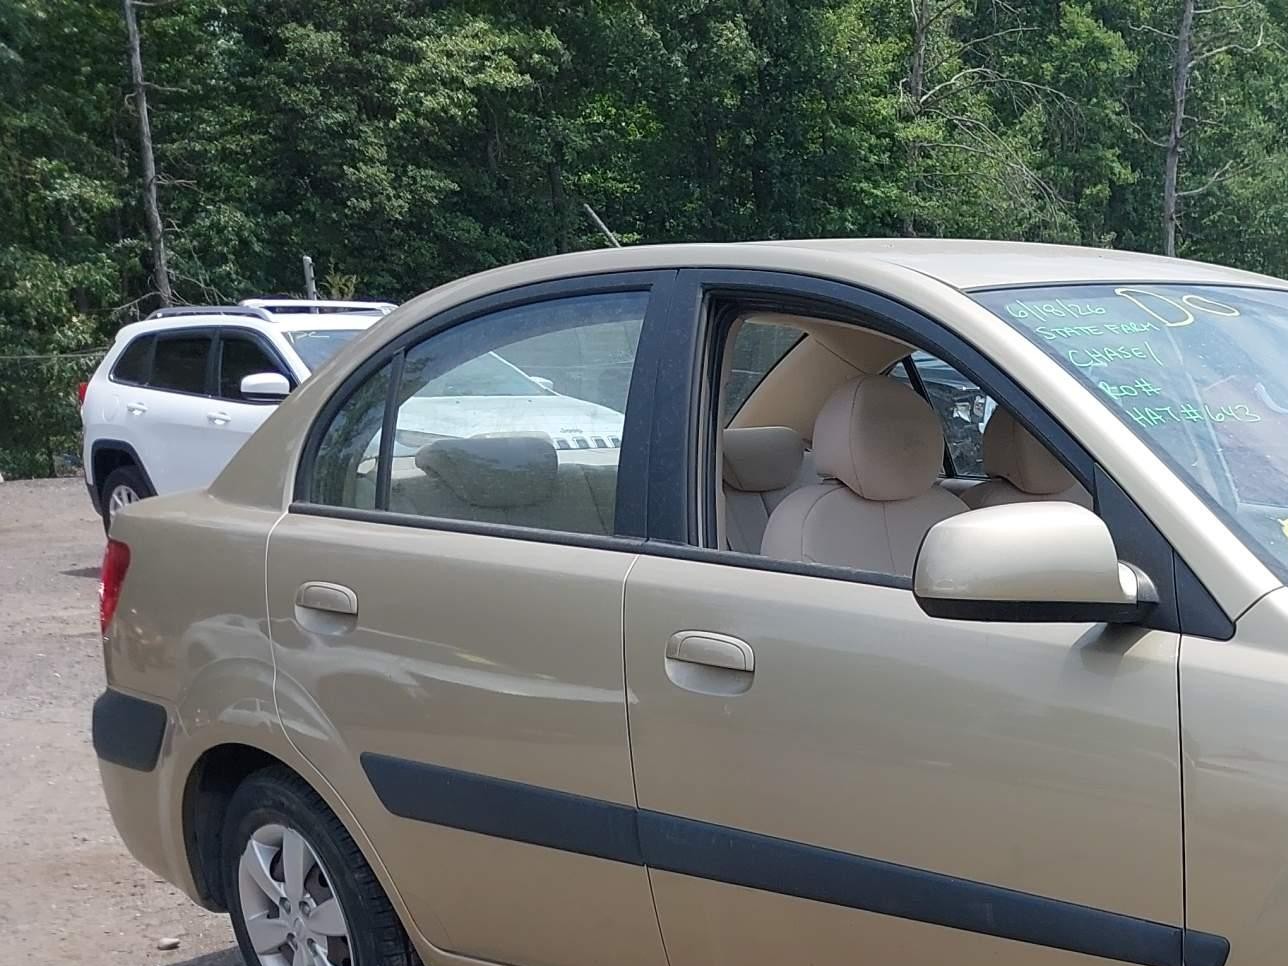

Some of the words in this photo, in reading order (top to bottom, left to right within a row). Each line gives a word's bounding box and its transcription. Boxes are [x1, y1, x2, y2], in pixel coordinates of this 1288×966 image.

[1006, 299, 1106, 322] 6/18/26
[1036, 324, 1104, 341] STATE
[1105, 321, 1161, 336] FARM
